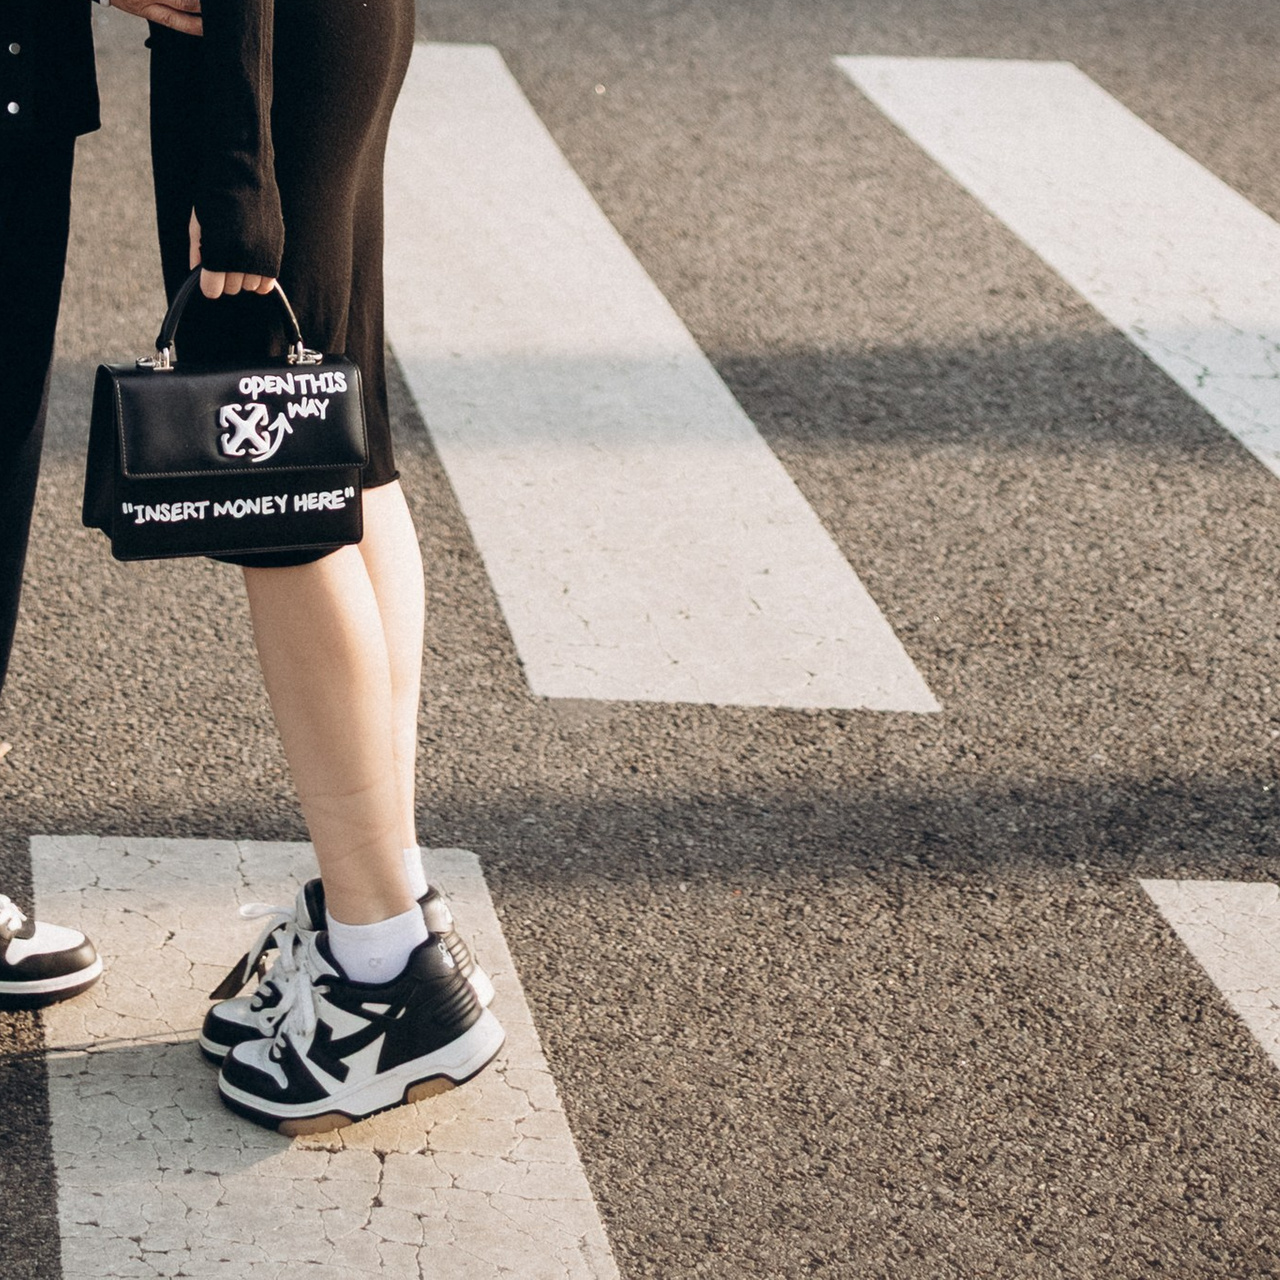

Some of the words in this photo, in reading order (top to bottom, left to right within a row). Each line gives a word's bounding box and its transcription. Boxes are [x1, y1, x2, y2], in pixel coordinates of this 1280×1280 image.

[239, 372, 296, 400] OPEN
[296, 372, 347, 394] THIS
[287, 397, 329, 420] WAY
[122, 501, 210, 524] "INSERT
[214, 494, 289, 518] MONEY
[294, 486, 354, 512] HERE"
